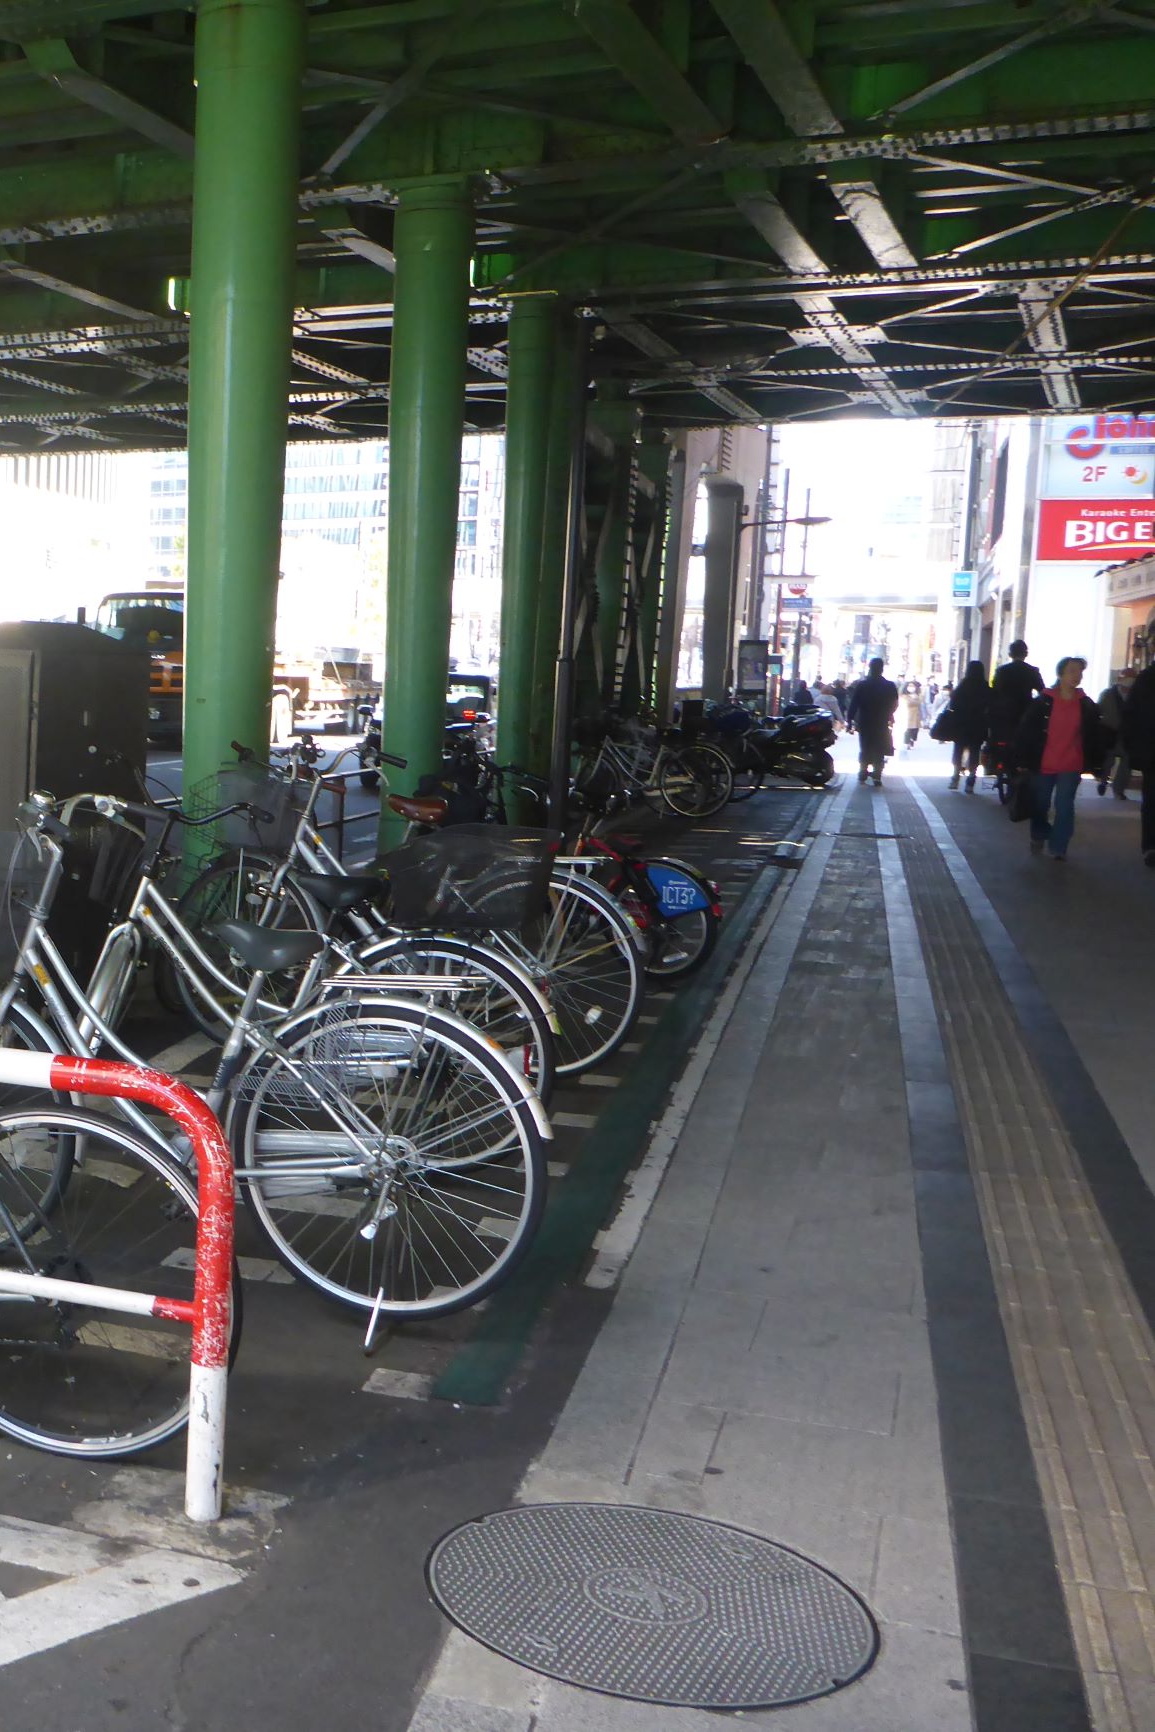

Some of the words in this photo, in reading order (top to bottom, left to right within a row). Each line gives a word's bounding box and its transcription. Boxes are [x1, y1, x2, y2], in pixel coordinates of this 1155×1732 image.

[1082, 466, 1107, 482] 2F
[1080, 508, 1126, 517] Karaoke
[1064, 520, 1130, 548] BIG
